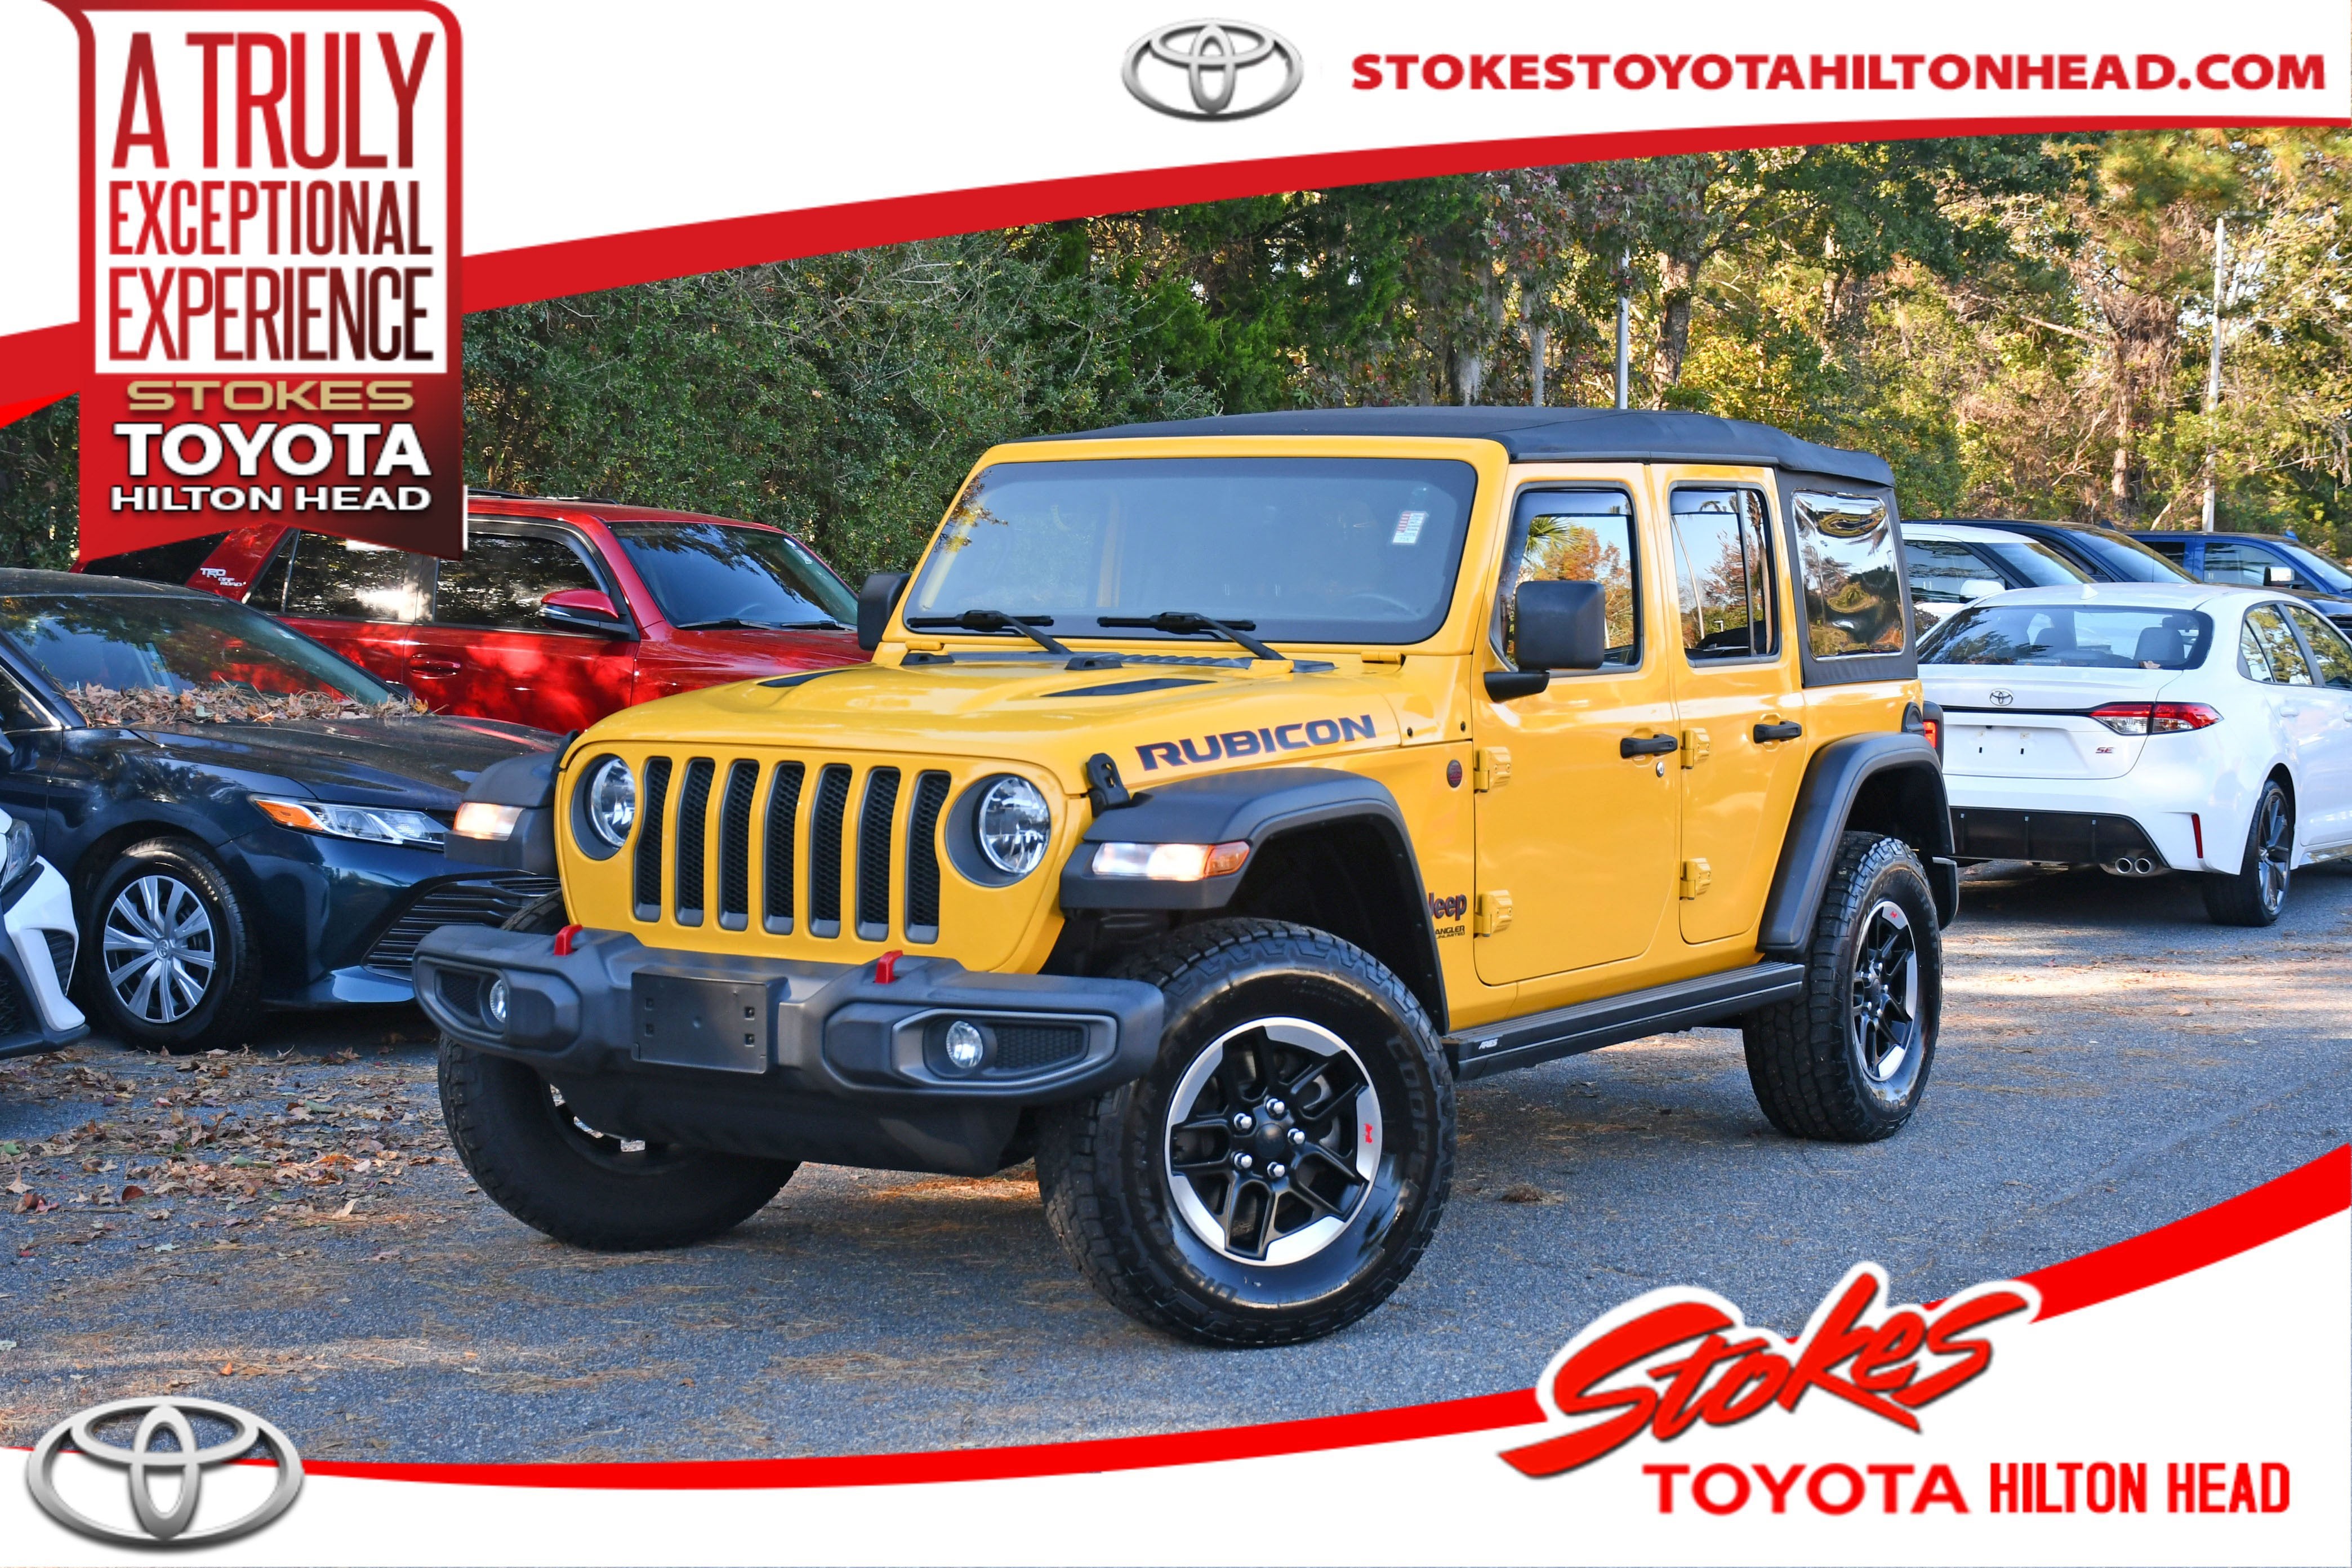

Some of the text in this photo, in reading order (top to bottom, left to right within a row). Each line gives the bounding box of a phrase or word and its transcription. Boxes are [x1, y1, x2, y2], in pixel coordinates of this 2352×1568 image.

[200, 567, 226, 578] TRD
[1135, 715, 1377, 771] RUBICON
[1428, 892, 1467, 921] Jeep
[1435, 925, 1465, 935] ANGLER
